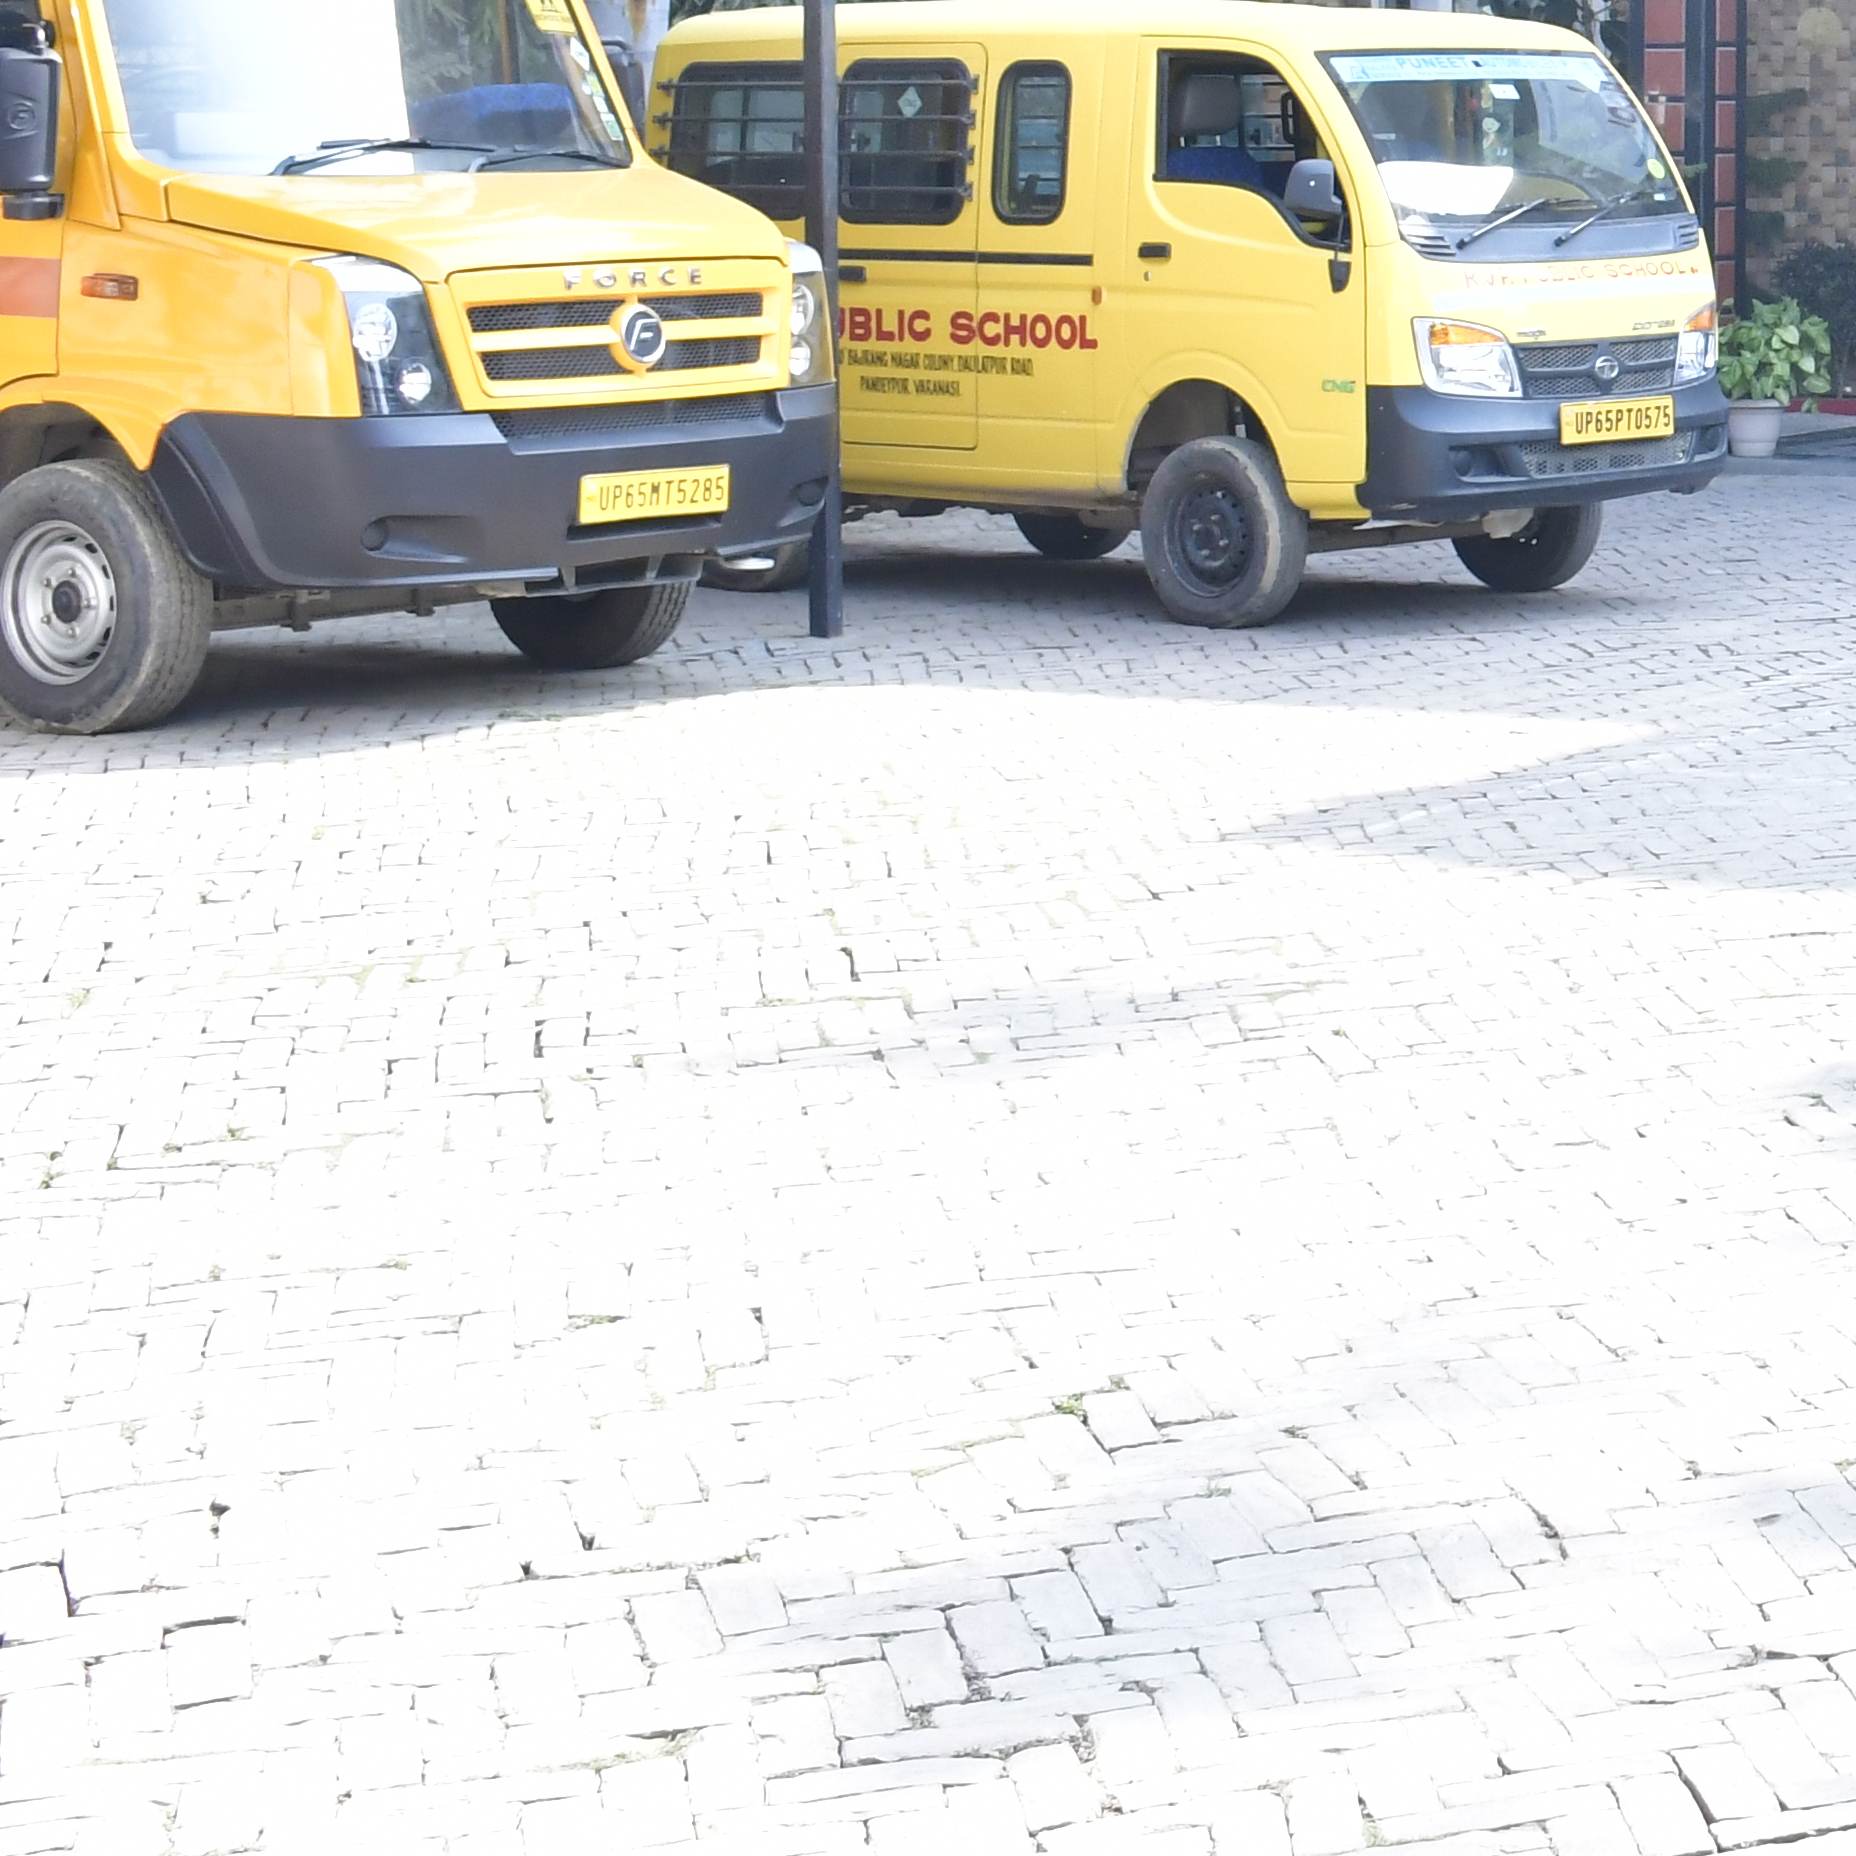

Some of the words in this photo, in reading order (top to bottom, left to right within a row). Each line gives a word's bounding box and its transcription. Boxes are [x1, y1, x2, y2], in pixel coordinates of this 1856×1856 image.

[1395, 55, 1469, 71] PUNEET
[563, 267, 703, 291] FORCE
[1603, 260, 1686, 279] SCHOOL
[950, 310, 1098, 350] SCHOOL
[1575, 404, 1671, 435] UP65PT0575
[599, 476, 725, 511] UP65MT5285
